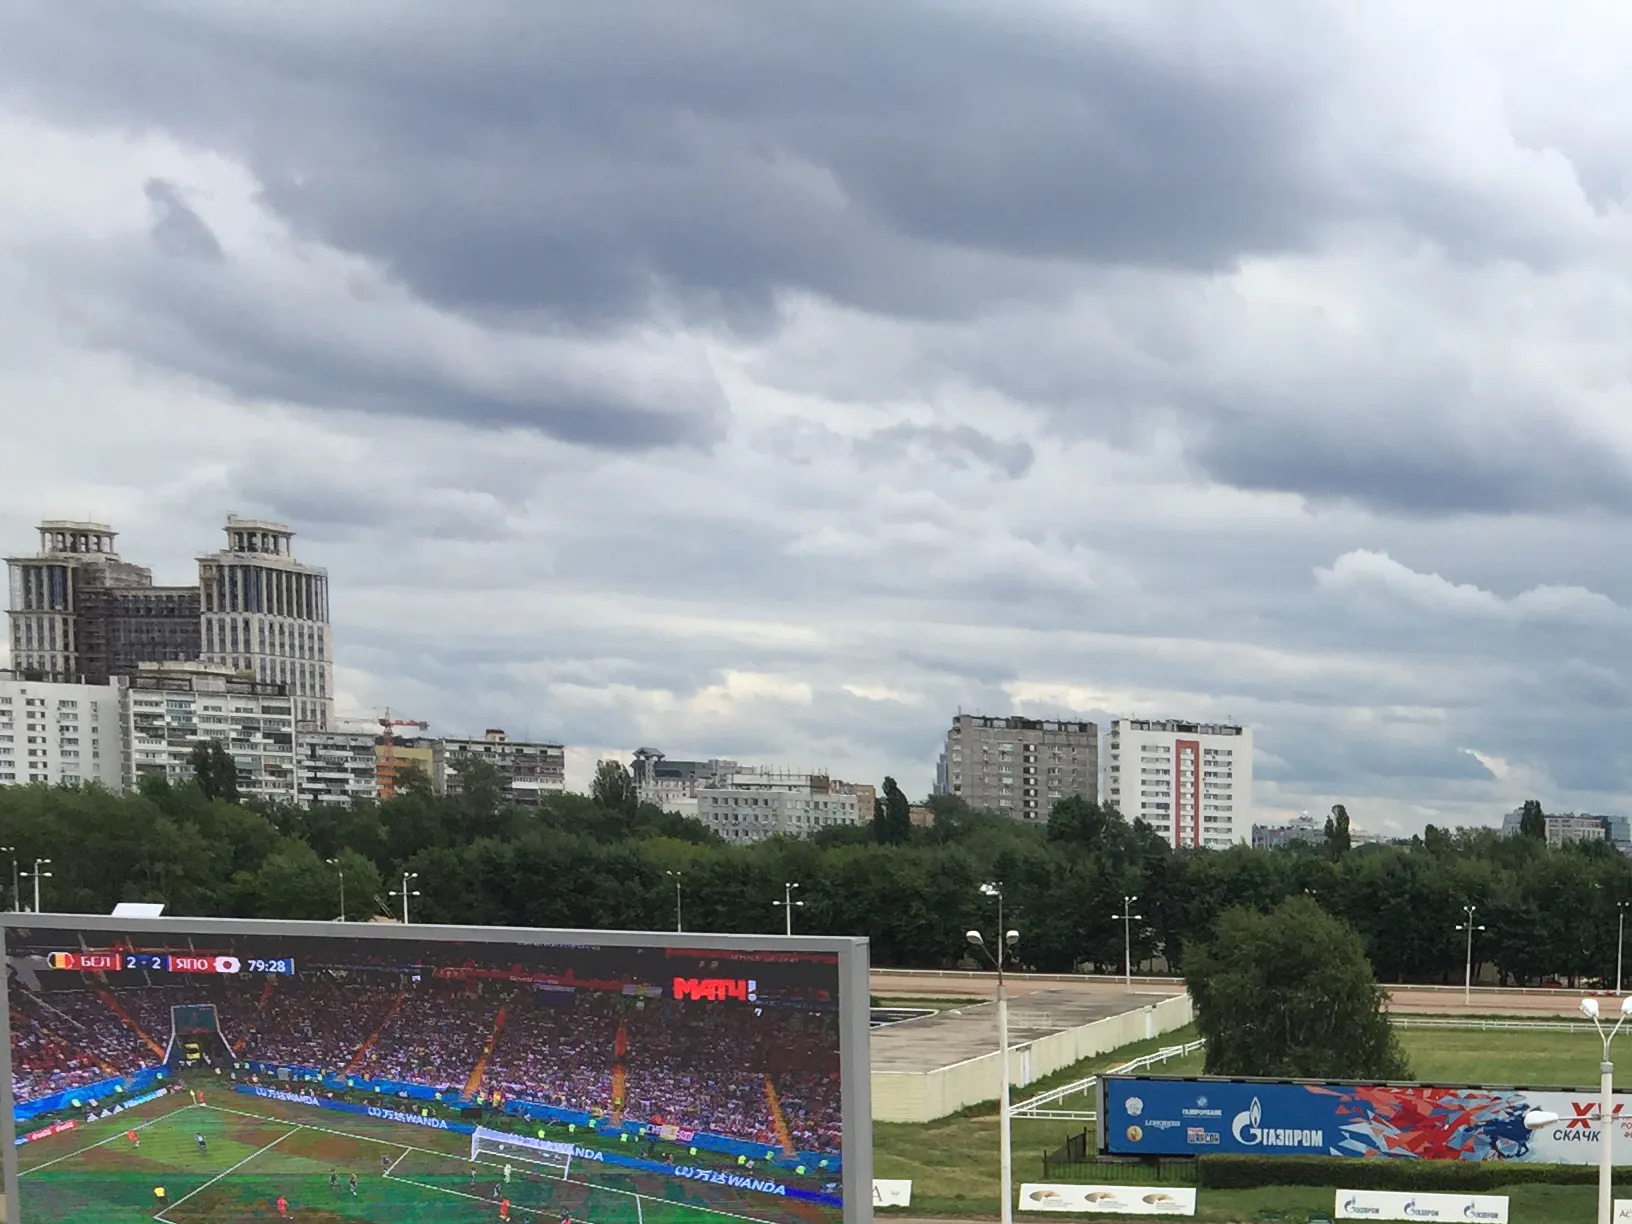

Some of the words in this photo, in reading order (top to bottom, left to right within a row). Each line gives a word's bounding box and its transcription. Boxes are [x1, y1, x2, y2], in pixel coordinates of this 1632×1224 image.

[81, 956, 111, 967] БЕЛ
[126, 956, 136, 968] 2
[151, 957, 161, 969] 2
[176, 959, 208, 970] ЯПО
[247, 960, 286, 972] 79:28
[1263, 1128, 1323, 1147] ГАЗПРОМ
[1553, 1129, 1601, 1142] СКАЧК
[728, 1175, 786, 1196] WANDA
